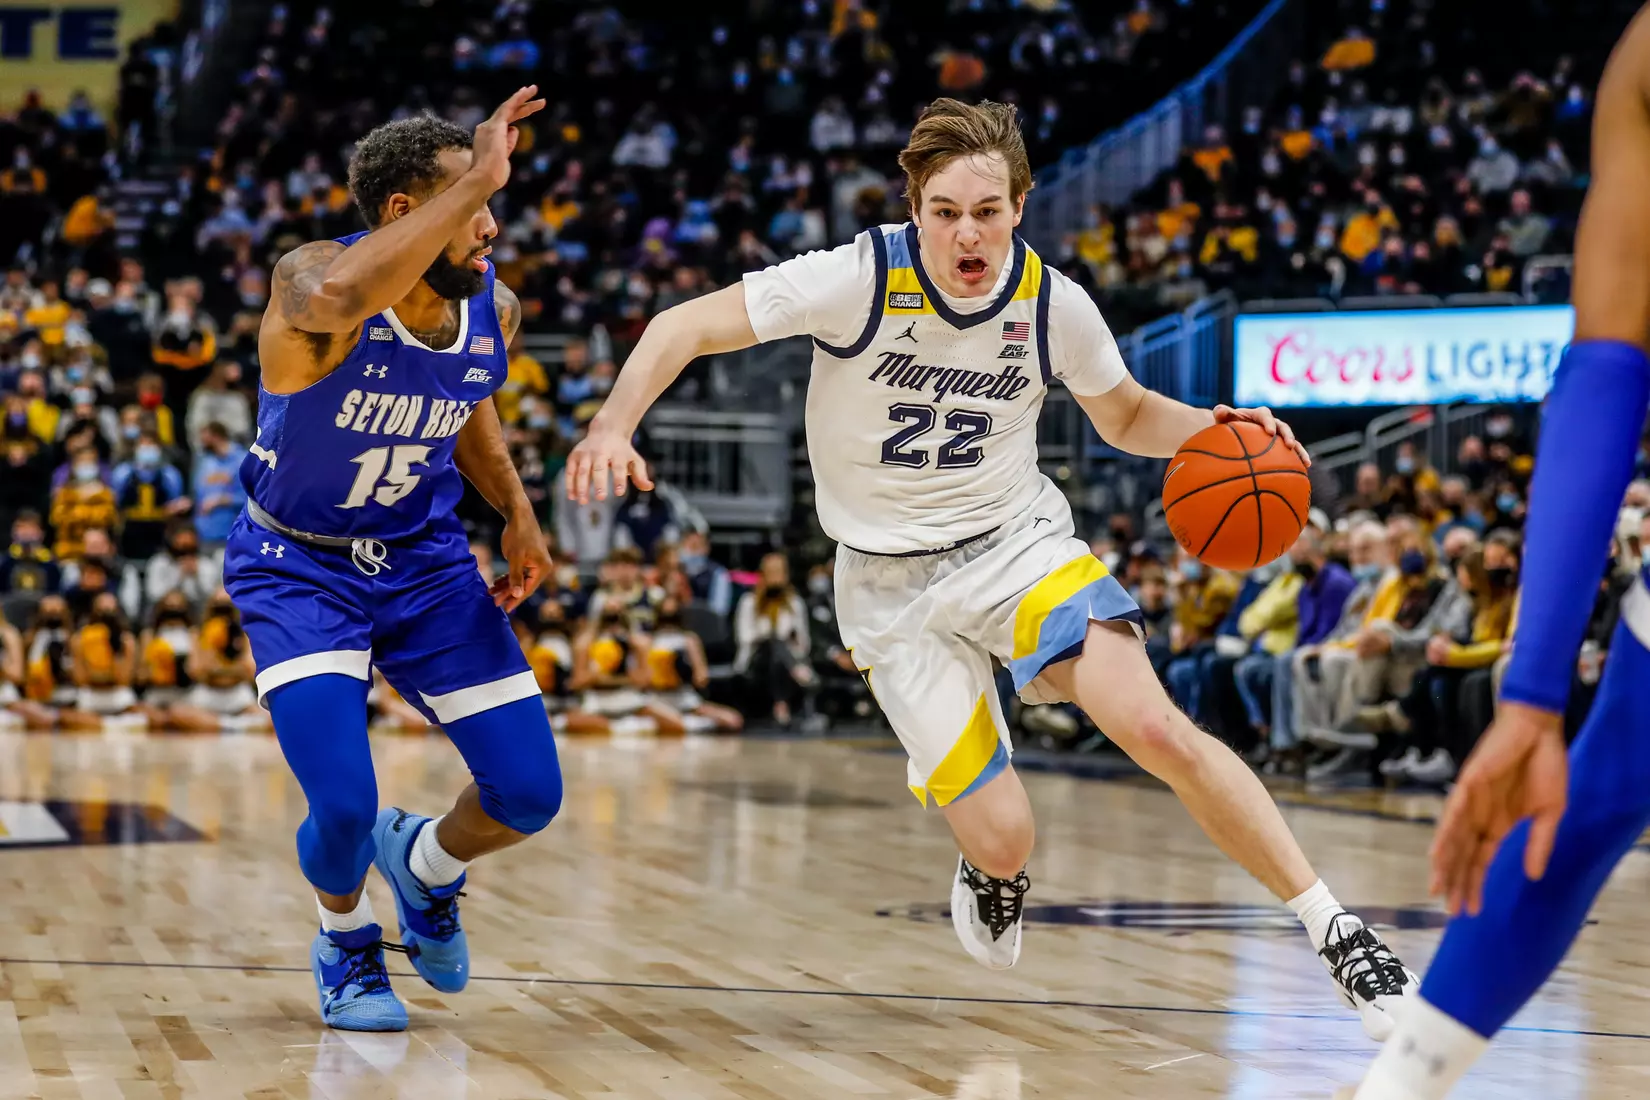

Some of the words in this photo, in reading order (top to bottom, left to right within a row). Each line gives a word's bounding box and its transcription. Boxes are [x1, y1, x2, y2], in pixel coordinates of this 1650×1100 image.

[463, 373, 493, 382] EAST
[467, 367, 489, 376] BIG
[868, 351, 1031, 403] Marquette
[1000, 350, 1029, 358] EAST
[1266, 329, 1414, 384] Coors
[334, 389, 425, 438] SETON
[880, 402, 993, 470] 22
[334, 444, 436, 510] 15
